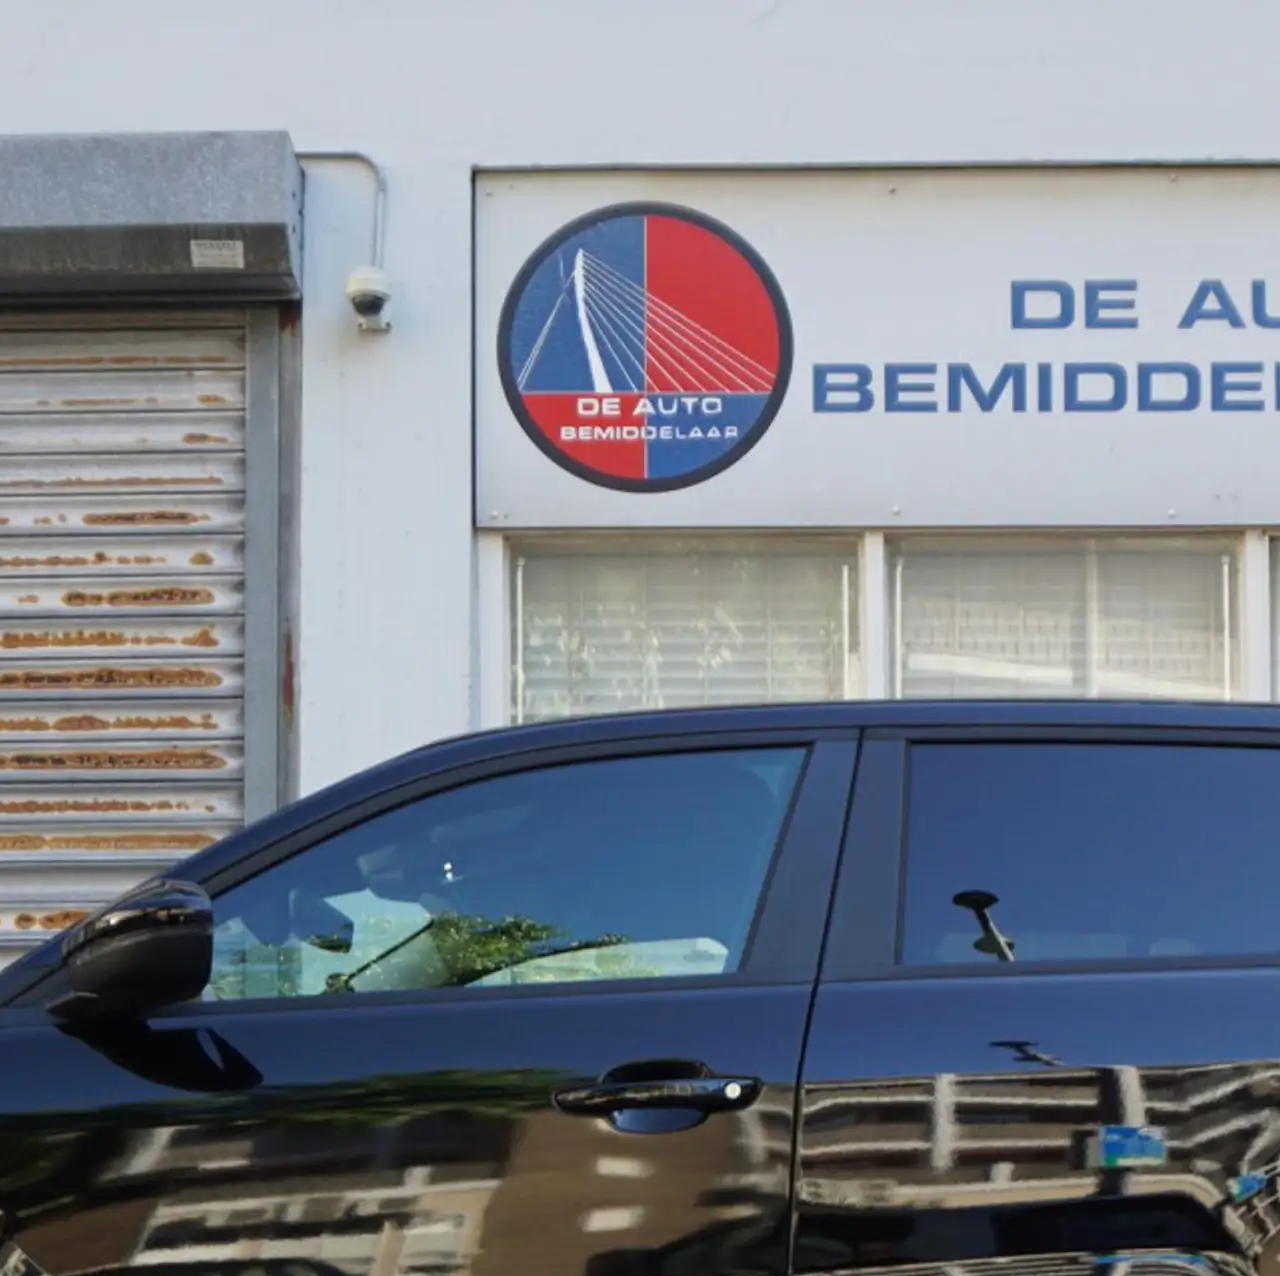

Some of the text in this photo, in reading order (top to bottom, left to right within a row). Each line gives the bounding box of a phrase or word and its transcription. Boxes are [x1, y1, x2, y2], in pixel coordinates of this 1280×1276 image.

[1010, 279, 1140, 330] DE
[576, 396, 724, 417] DE AUTO
[558, 425, 739, 441] BEMIDDELAAR
